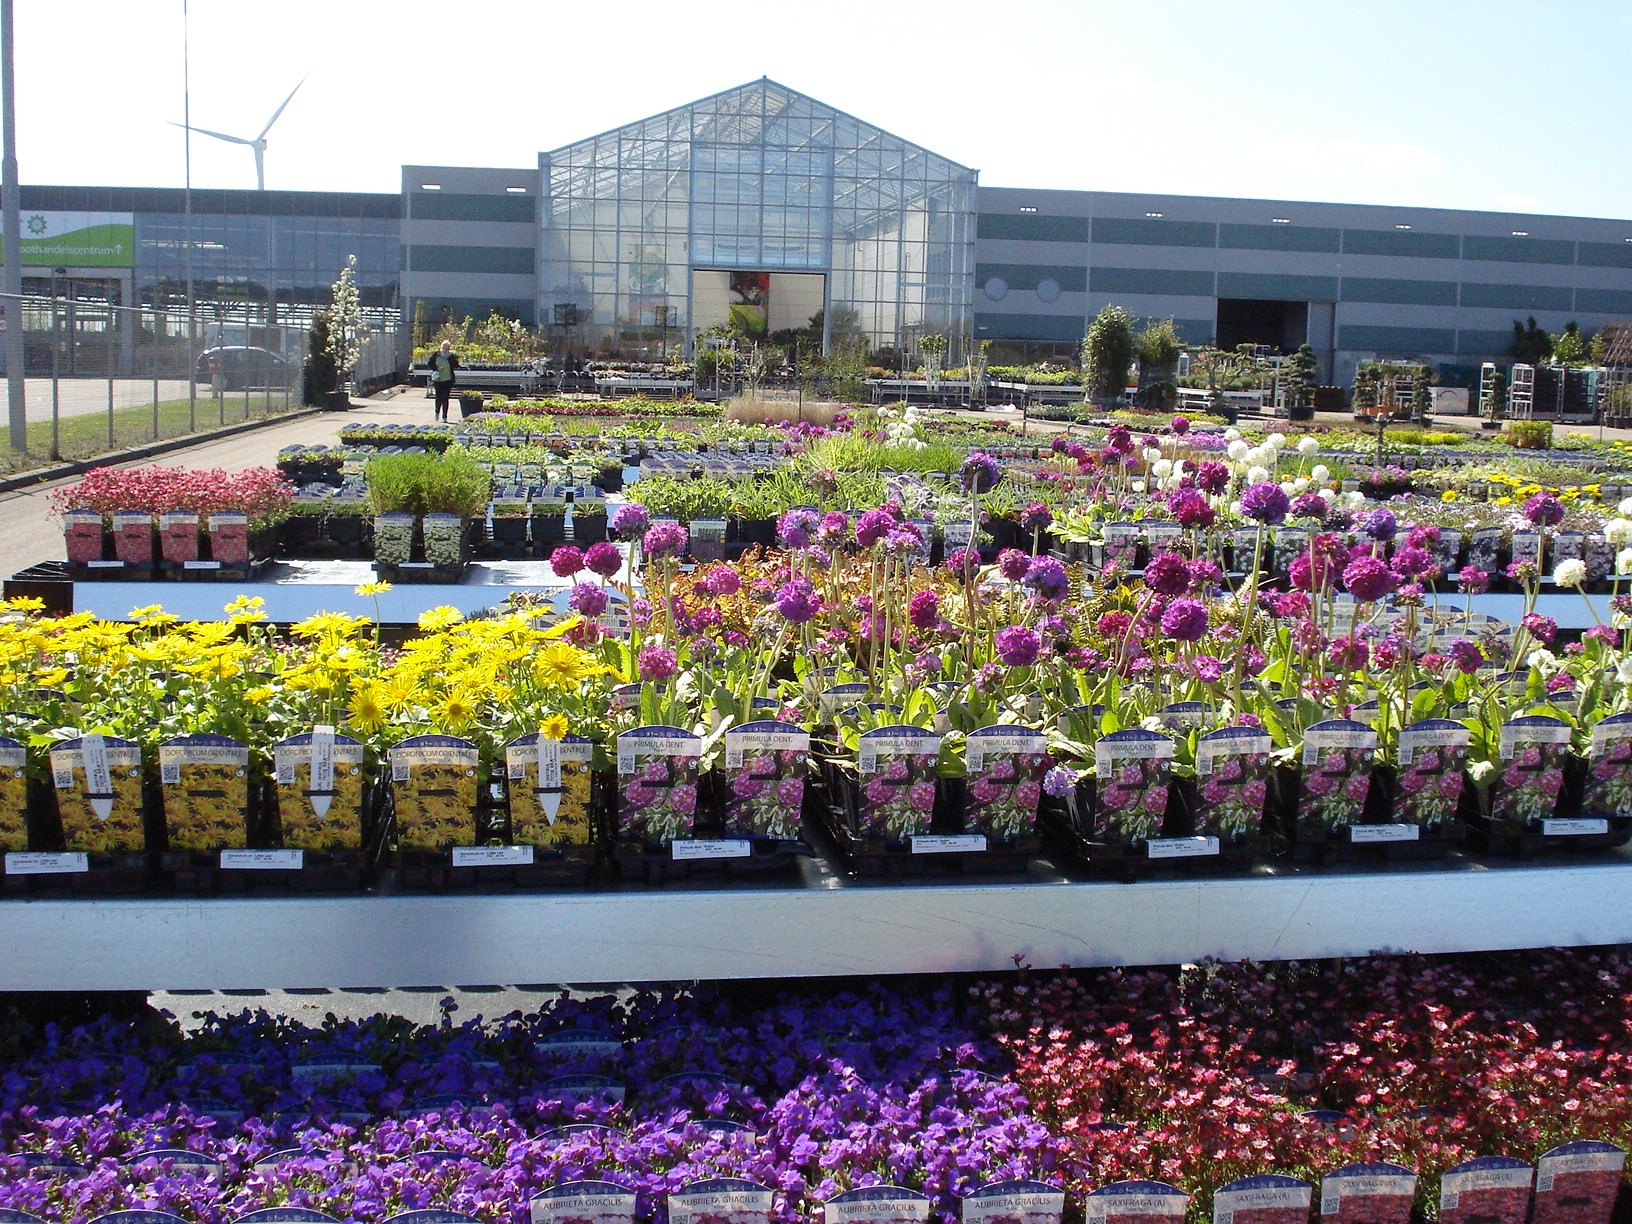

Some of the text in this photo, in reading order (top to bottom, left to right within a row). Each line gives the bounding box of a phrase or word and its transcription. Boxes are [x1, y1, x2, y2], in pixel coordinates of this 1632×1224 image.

[20, 245, 114, 255] oothandelscentrum
[165, 749, 240, 758] DORONICUM ORIENTALE
[280, 748, 312, 756] DORONIC
[396, 750, 472, 758] DORONICUM ORIENTALE
[512, 748, 538, 756] DORON
[681, 1197, 720, 1206] AUBRIETA
[1234, 1192, 1290, 1202] SAXIFRAGA (A)
[544, 1198, 622, 1210] AUBRIETA GRACILIS
[974, 1199, 1013, 1209] AUBRIETA
[838, 1204, 916, 1214] AUBRIETA GRACILIS
